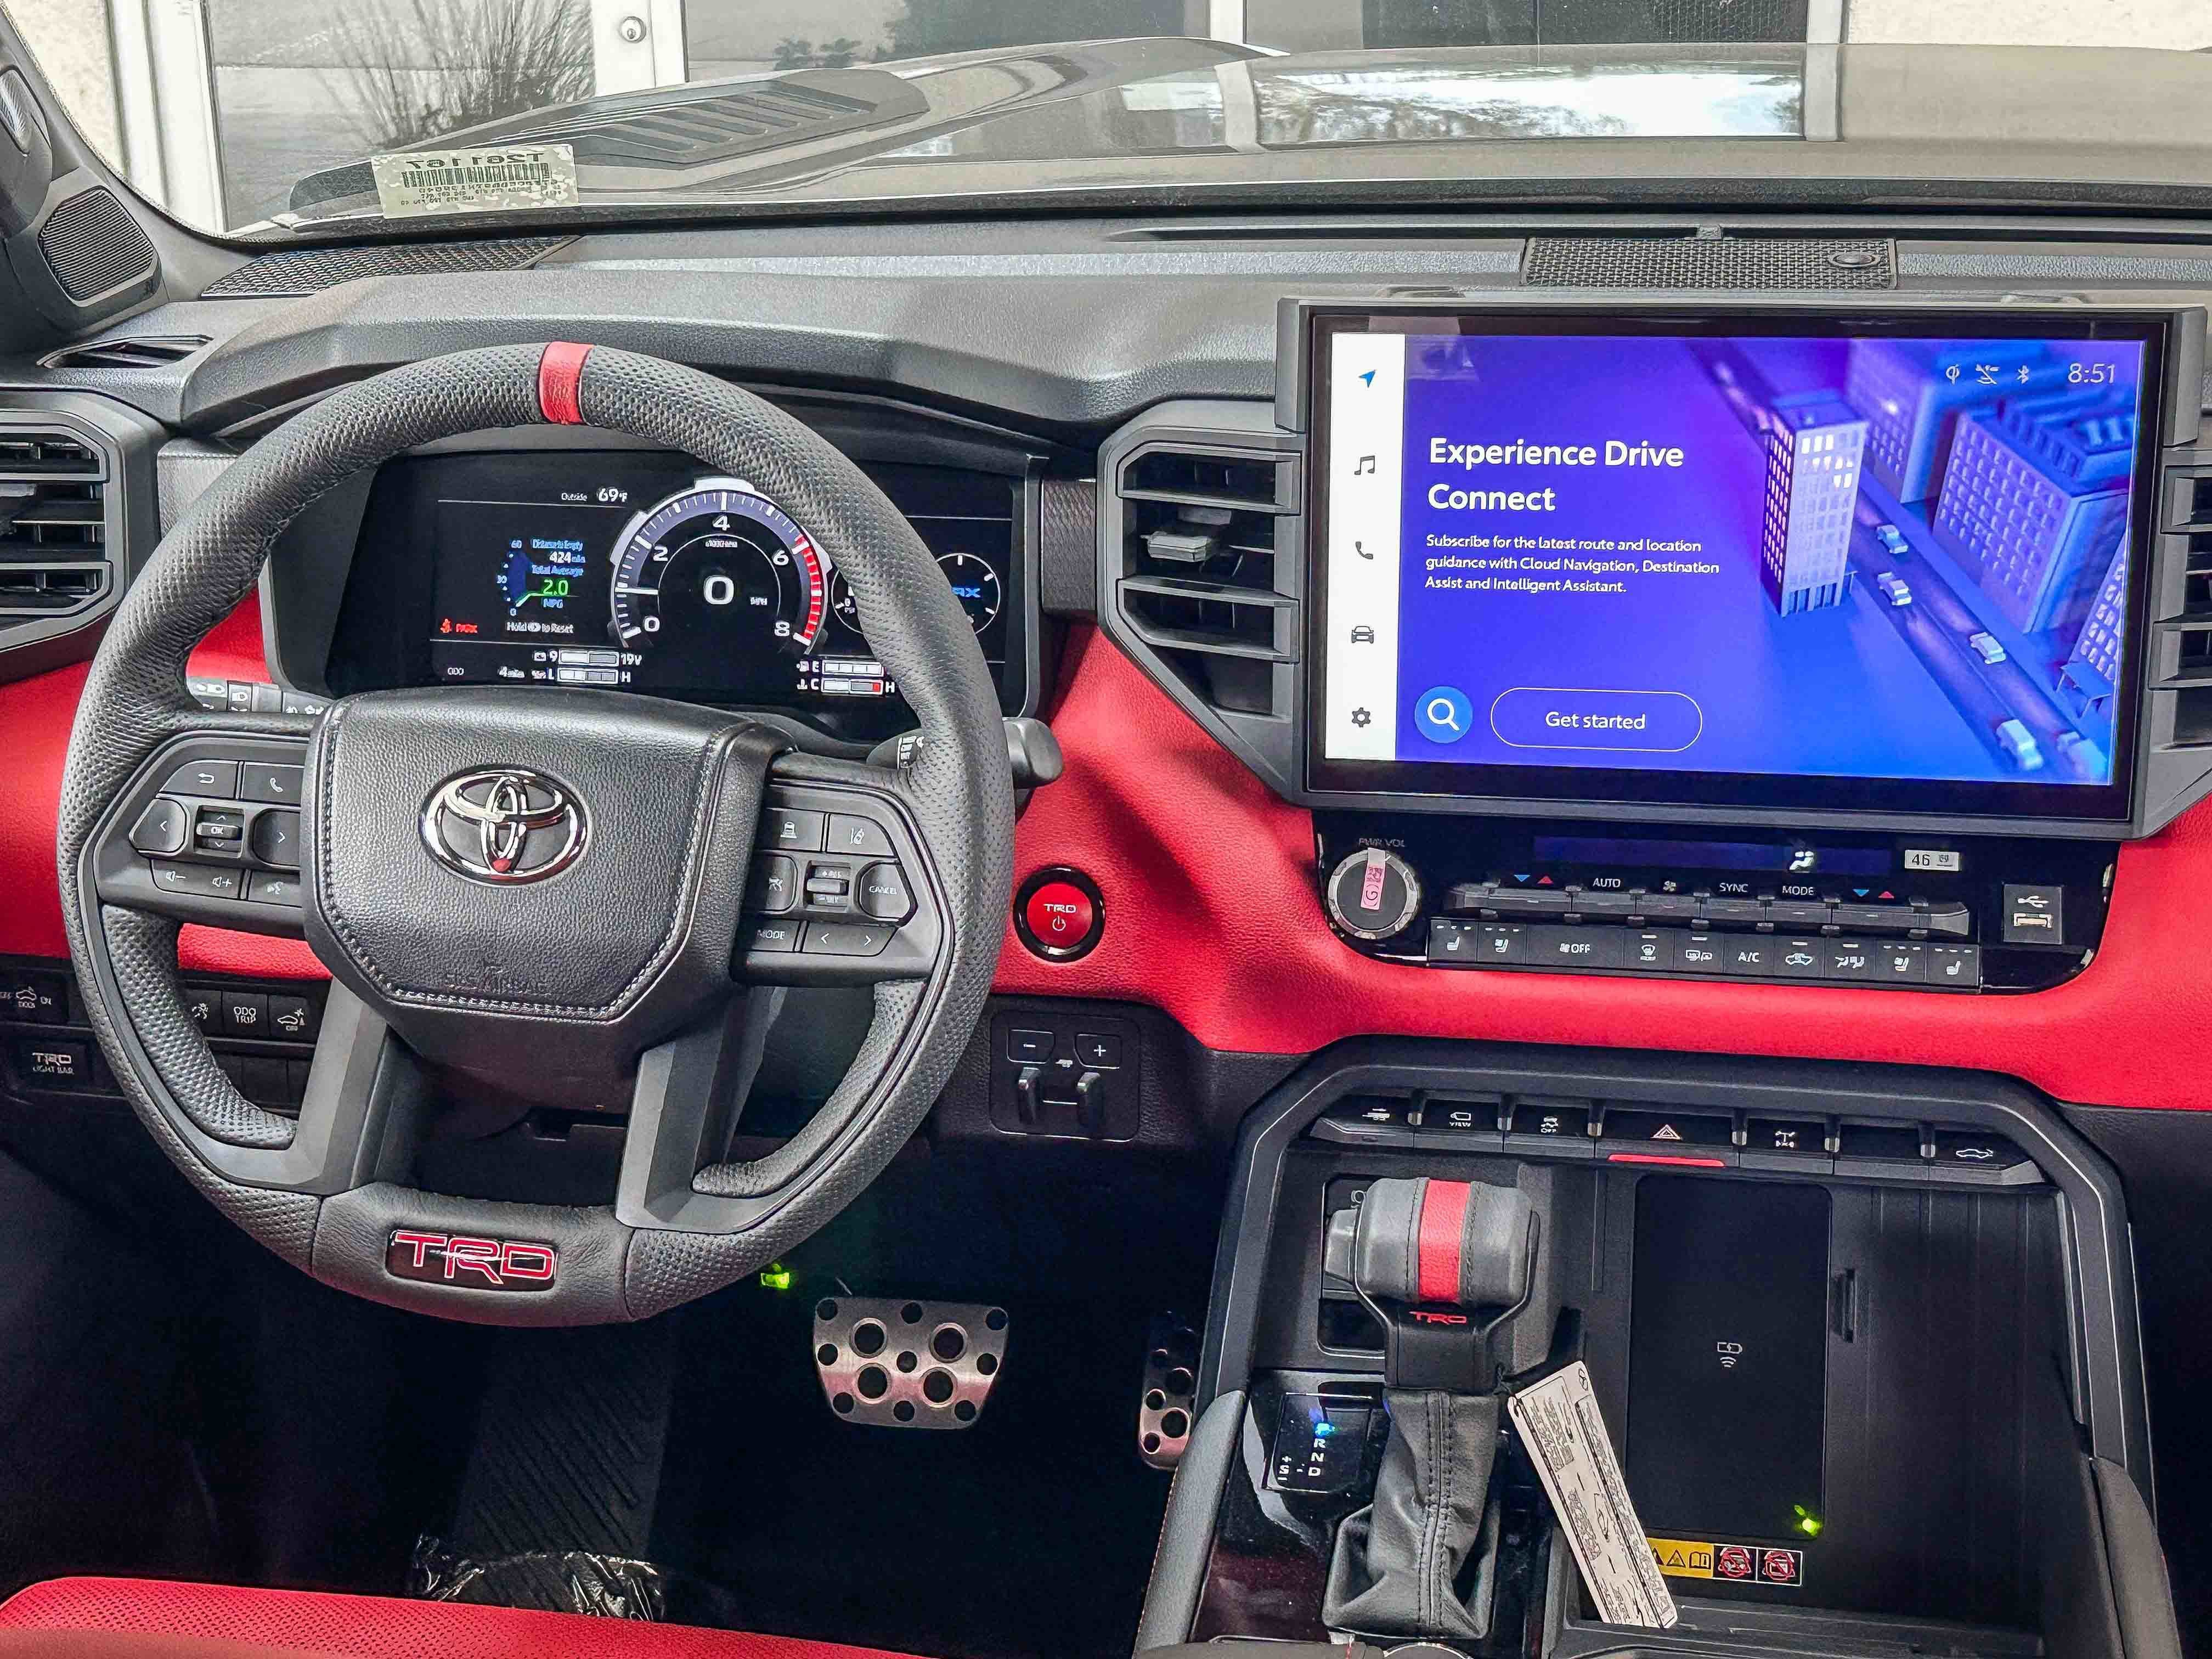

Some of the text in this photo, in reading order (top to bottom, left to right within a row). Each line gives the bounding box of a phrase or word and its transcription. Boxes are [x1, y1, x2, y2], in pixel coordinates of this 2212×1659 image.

[2068, 363, 2115, 383] 8:51
[1430, 437, 1684, 470] Experience Drive
[1427, 483, 1556, 511] Connect
[713, 515, 731, 531] 4
[1426, 534, 1702, 552] Subscribe for the latest route and location
[653, 546, 668, 561] 2
[772, 549, 789, 566] 6
[1425, 556, 1720, 574] guidance with Cloud Navigation, Destination
[543, 579, 568, 596] 2.0
[704, 575, 734, 605] 0
[1425, 576, 1627, 593] Assist and Intelligent Assistant.
[644, 616, 661, 632] 0
[775, 620, 791, 637] 8
[812, 662, 820, 673] E
[621, 671, 631, 682] H
[811, 678, 895, 693] C H
[1545, 711, 1646, 730] Get started
[1911, 854, 1932, 866] 46
[1593, 878, 1621, 888] AUTO
[1719, 882, 1749, 893] SYNC
[1782, 885, 1814, 896] MODE
[1043, 904, 1076, 913] TRD
[1571, 943, 1590, 955] OFF
[1737, 952, 1760, 963] A/C
[32, 1052, 72, 1066] TRD
[394, 1232, 554, 1285] TRD
[1409, 1311, 1467, 1325] TRD
[1313, 1438, 1326, 1448] R
[1311, 1452, 1324, 1462] N
[1279, 1465, 1290, 1475] S
[1308, 1467, 1321, 1477] D
